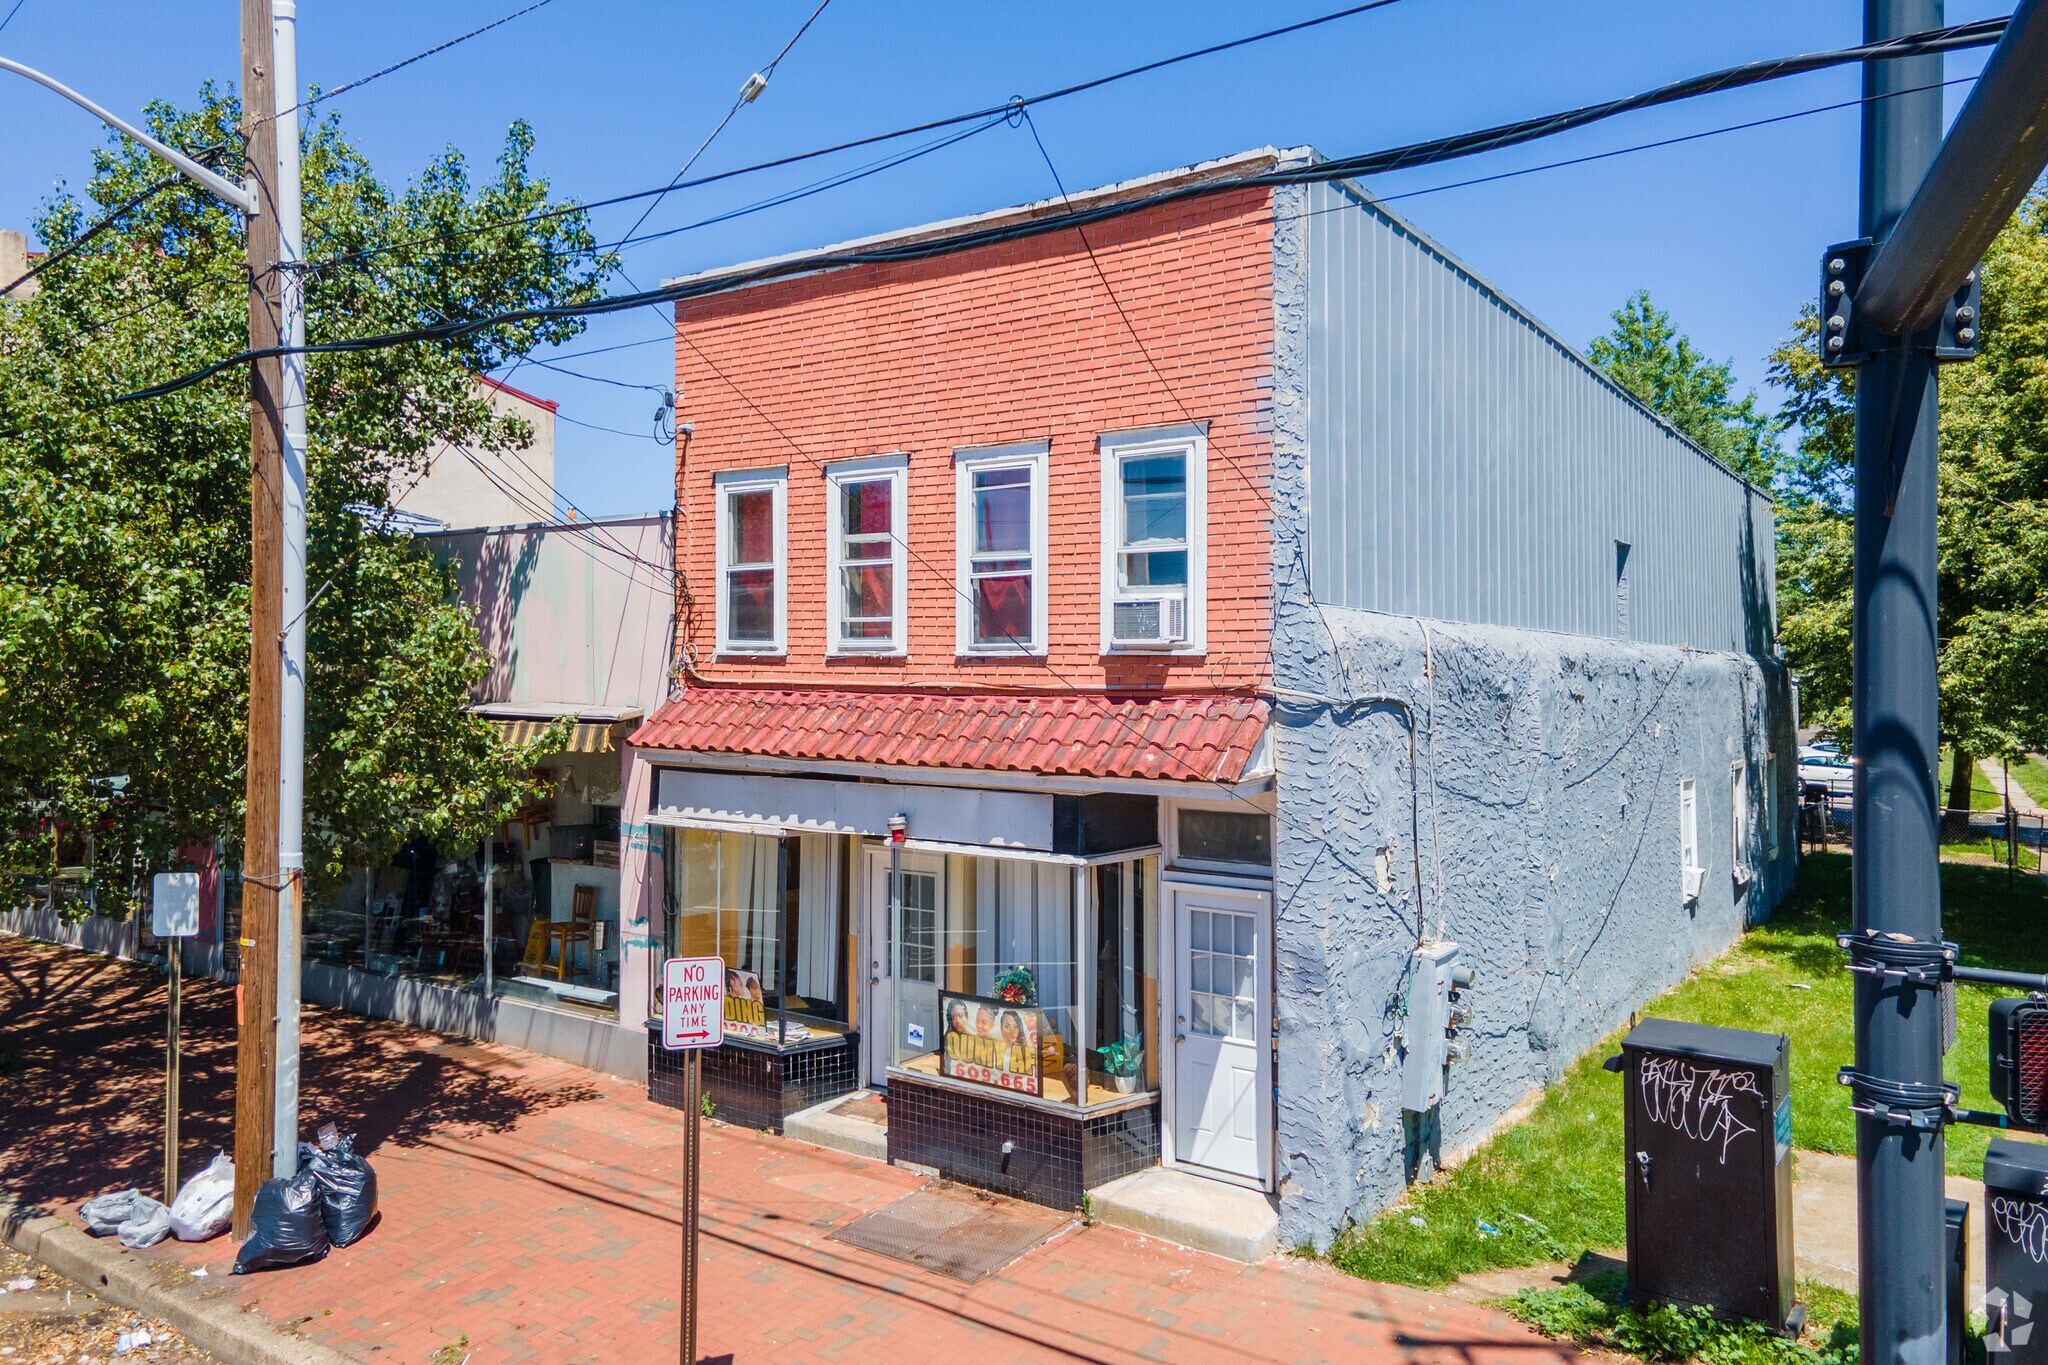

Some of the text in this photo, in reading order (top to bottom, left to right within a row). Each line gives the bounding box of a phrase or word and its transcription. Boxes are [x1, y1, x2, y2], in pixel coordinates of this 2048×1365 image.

[684, 966, 705, 983] NO
[669, 984, 719, 1003] PARKING
[682, 1003, 705, 1015] ANY
[723, 994, 766, 1028] DING
[680, 1015, 707, 1028] TIME
[947, 1031, 1038, 1077] OUMY AF
[955, 1062, 1036, 1095] 609.665
